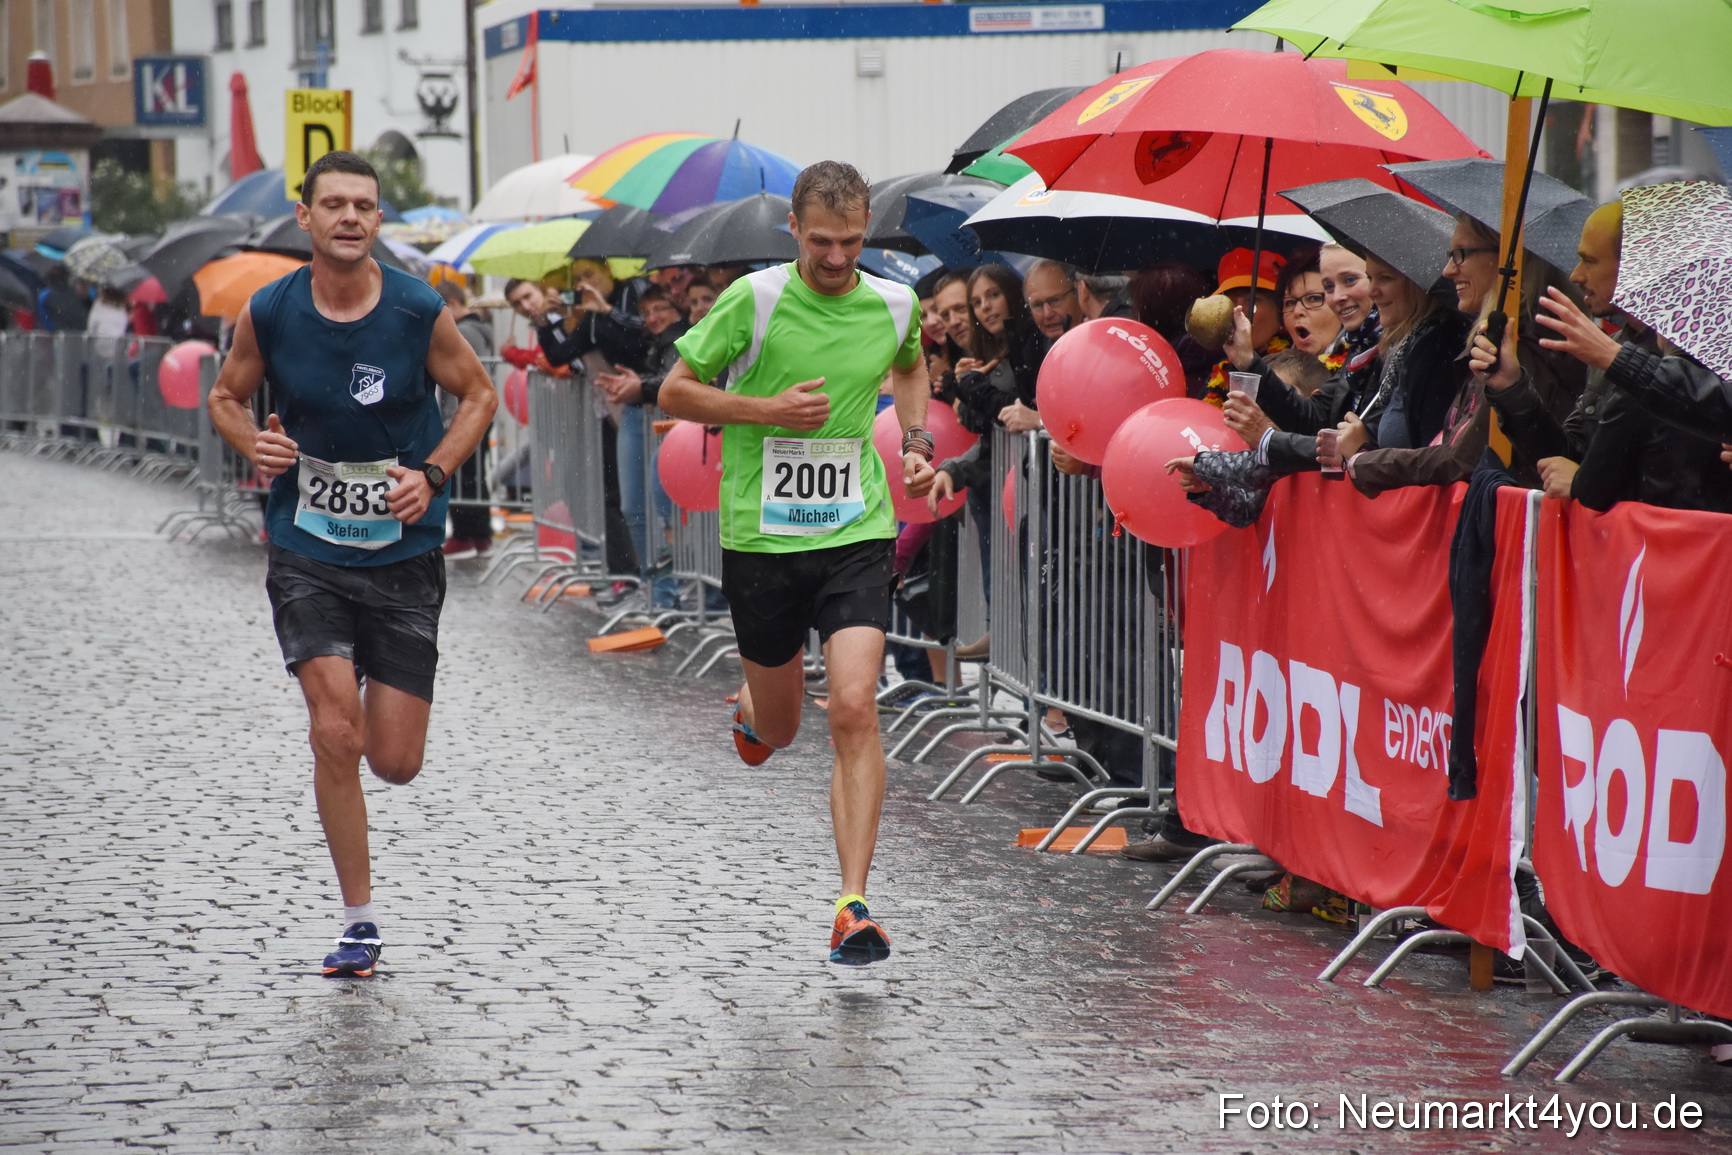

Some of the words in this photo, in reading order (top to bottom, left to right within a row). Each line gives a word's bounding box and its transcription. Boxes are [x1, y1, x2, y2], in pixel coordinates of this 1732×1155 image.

[143, 63, 199, 114] KL
[293, 93, 346, 114] Block
[303, 123, 335, 174] D
[896, 259, 920, 276] epp
[1139, 356, 1165, 389] energie
[358, 374, 375, 392] TSV
[360, 385, 379, 402] 1965
[772, 448, 805, 457] NeuerMarkt
[810, 441, 856, 455] BOCK
[341, 463, 390, 477] BOCK
[774, 462, 851, 500] 2001
[308, 476, 391, 516] 2833
[788, 508, 841, 524] Michael
[327, 521, 369, 538] Stefan
